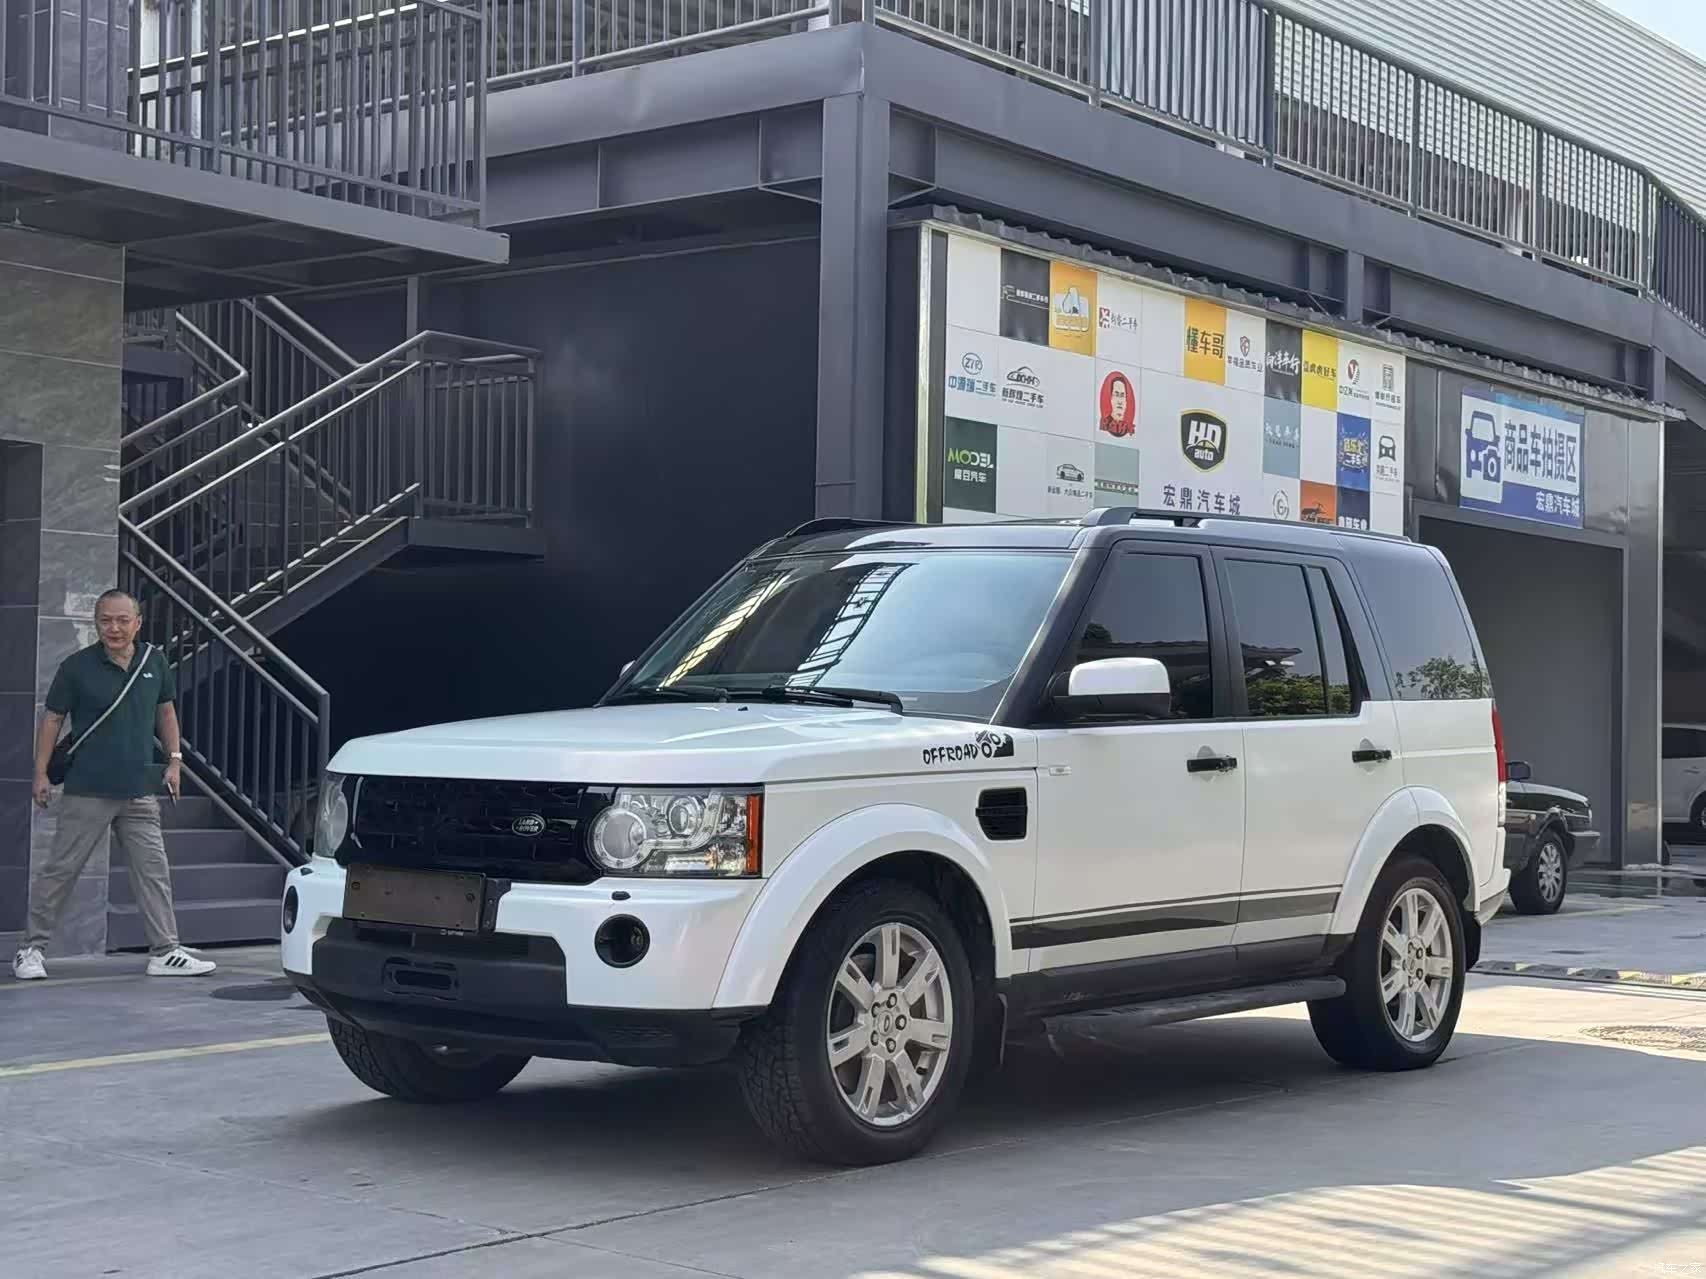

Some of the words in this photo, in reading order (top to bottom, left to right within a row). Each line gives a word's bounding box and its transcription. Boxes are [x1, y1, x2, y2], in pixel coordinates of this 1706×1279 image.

[1186, 325, 1225, 359] 懂车哥
[1188, 420, 1222, 452] HD
[947, 447, 995, 469] MODEL
[1194, 448, 1214, 461] auto
[1503, 418, 1577, 484] 商品车拍摄区
[1163, 484, 1241, 516] 宏鼎汽车城
[1535, 491, 1580, 518] 宏鼎汽车城
[922, 743, 979, 765] OFFROAD
